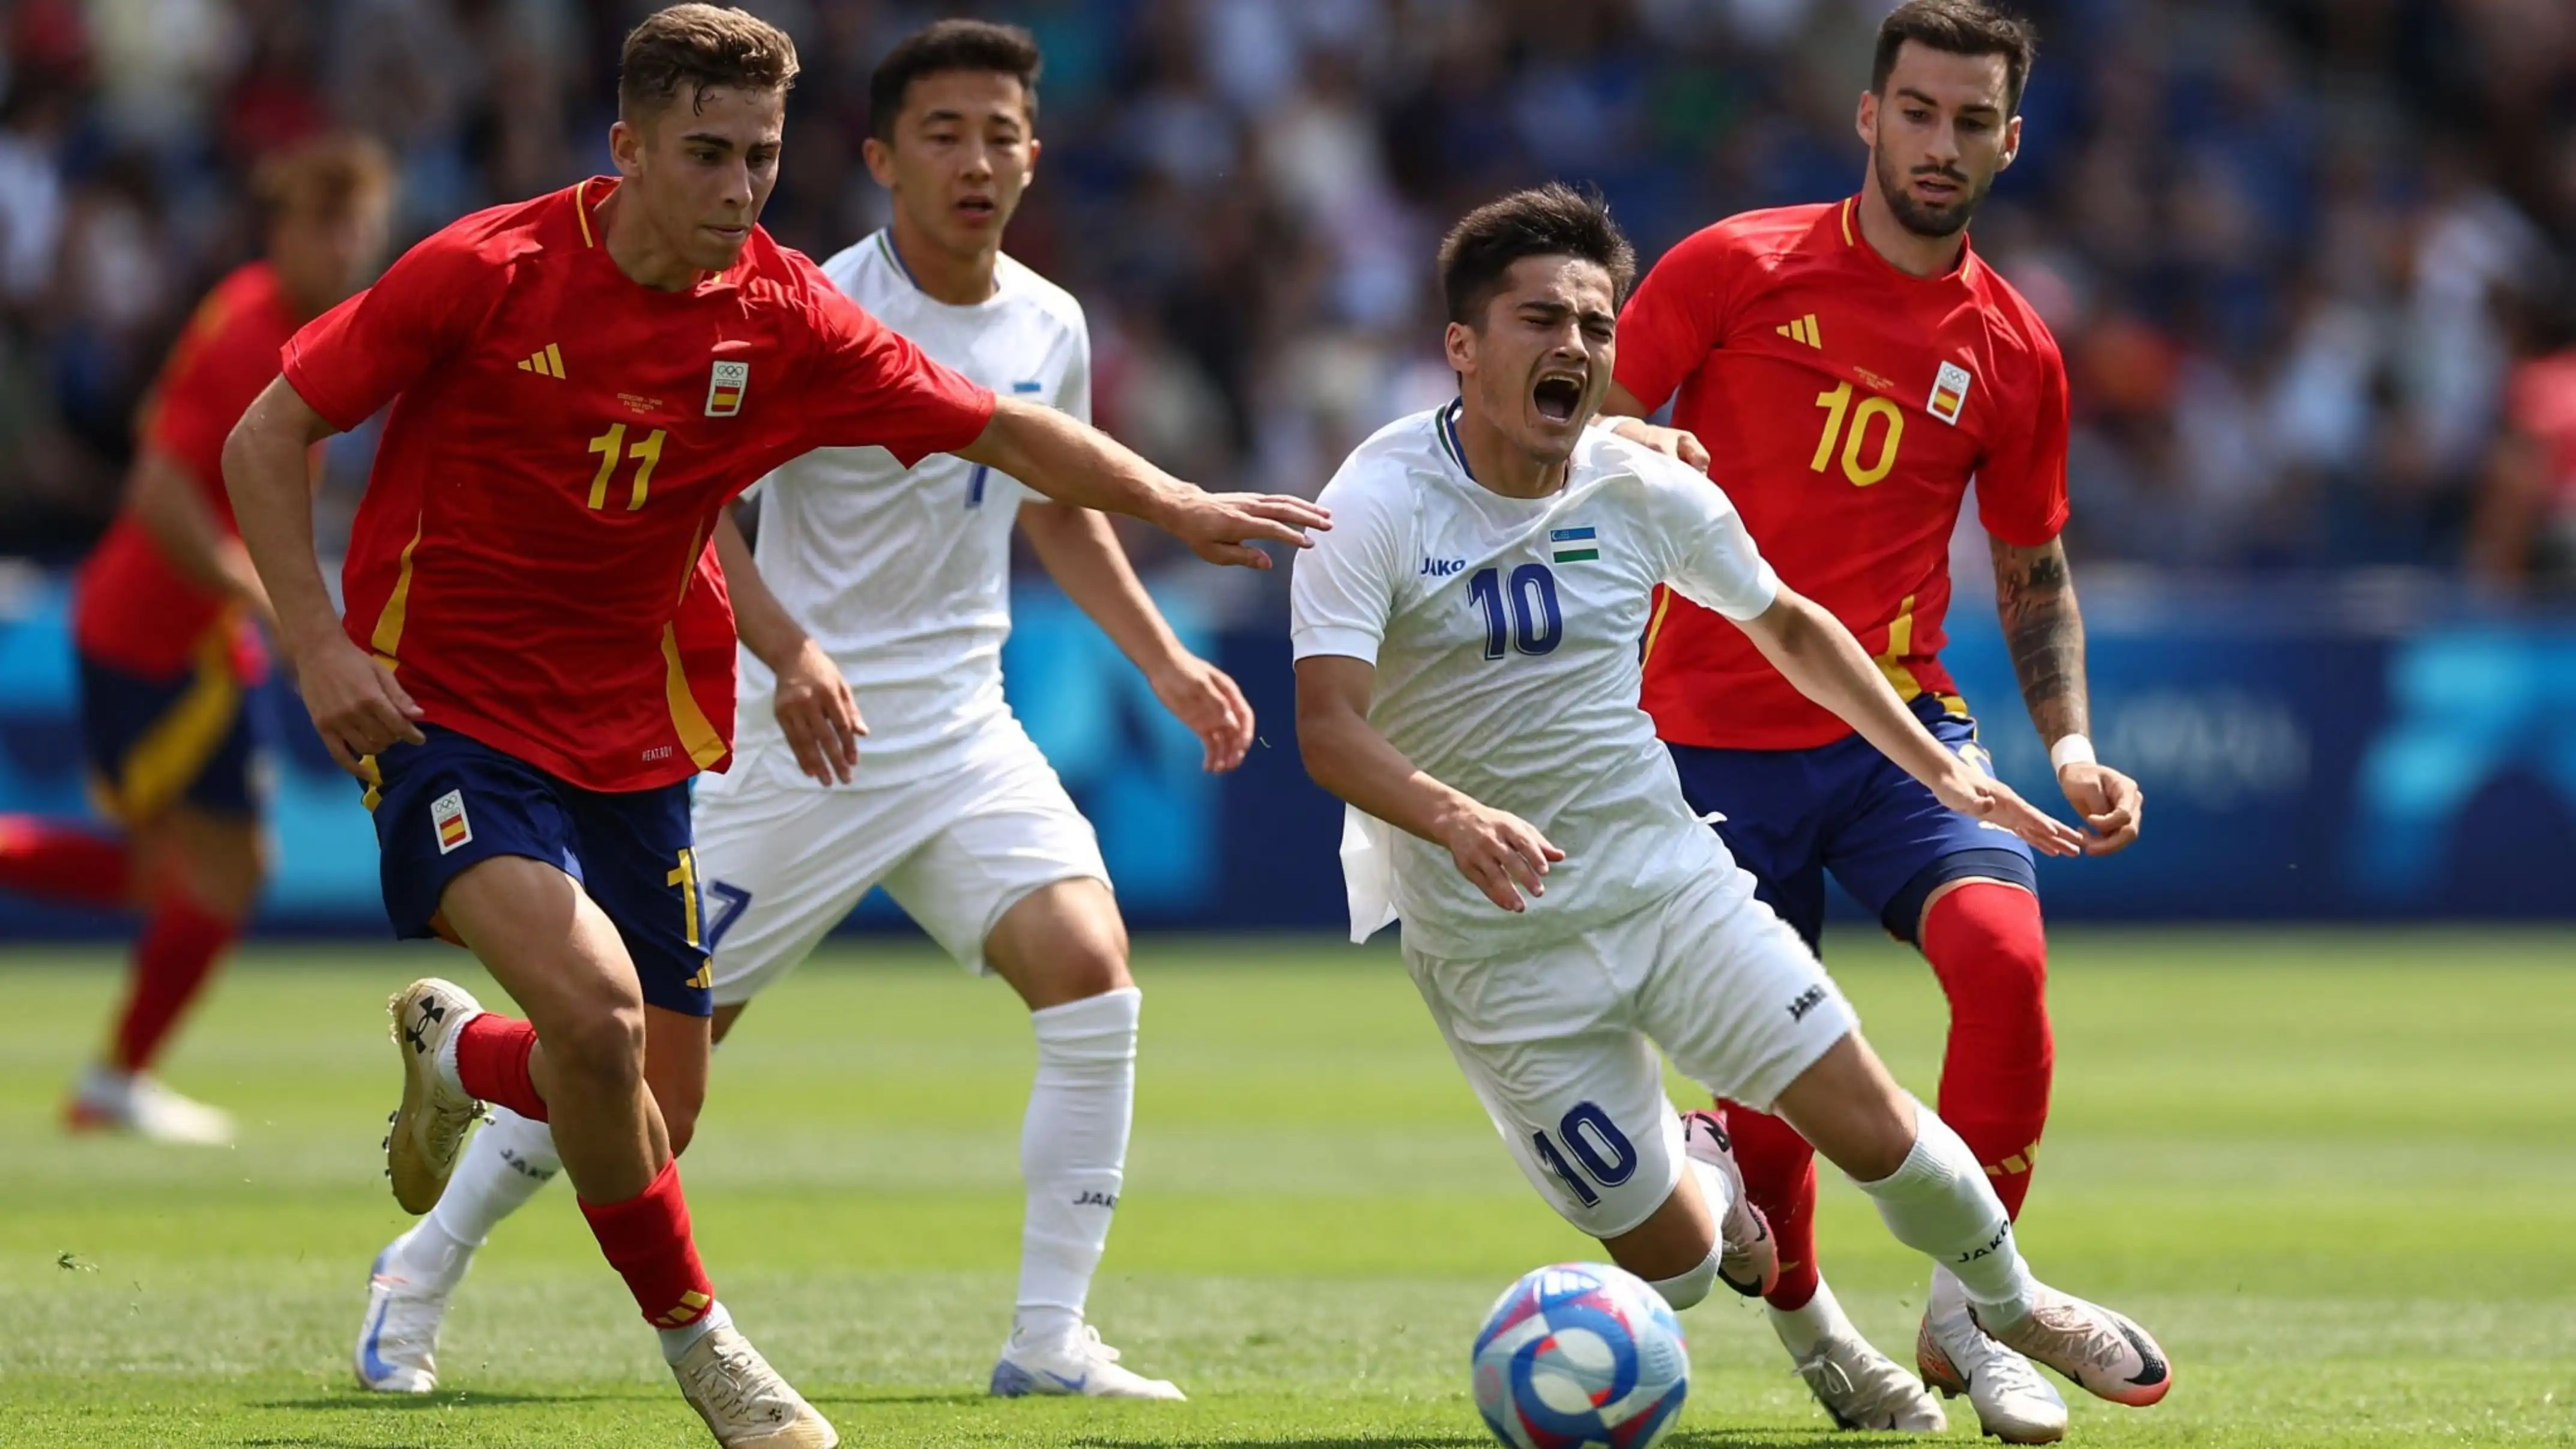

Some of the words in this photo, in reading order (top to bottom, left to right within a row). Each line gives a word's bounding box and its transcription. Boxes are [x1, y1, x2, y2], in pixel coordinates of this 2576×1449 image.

[588, 423, 667, 510] 11
[1810, 380, 1904, 487] 10
[1421, 557, 1466, 576] JAKO
[1466, 563, 1562, 661] 10
[706, 879, 752, 954] 7
[1532, 1100, 1637, 1209] 10
[1958, 1220, 2009, 1263] JAKO
